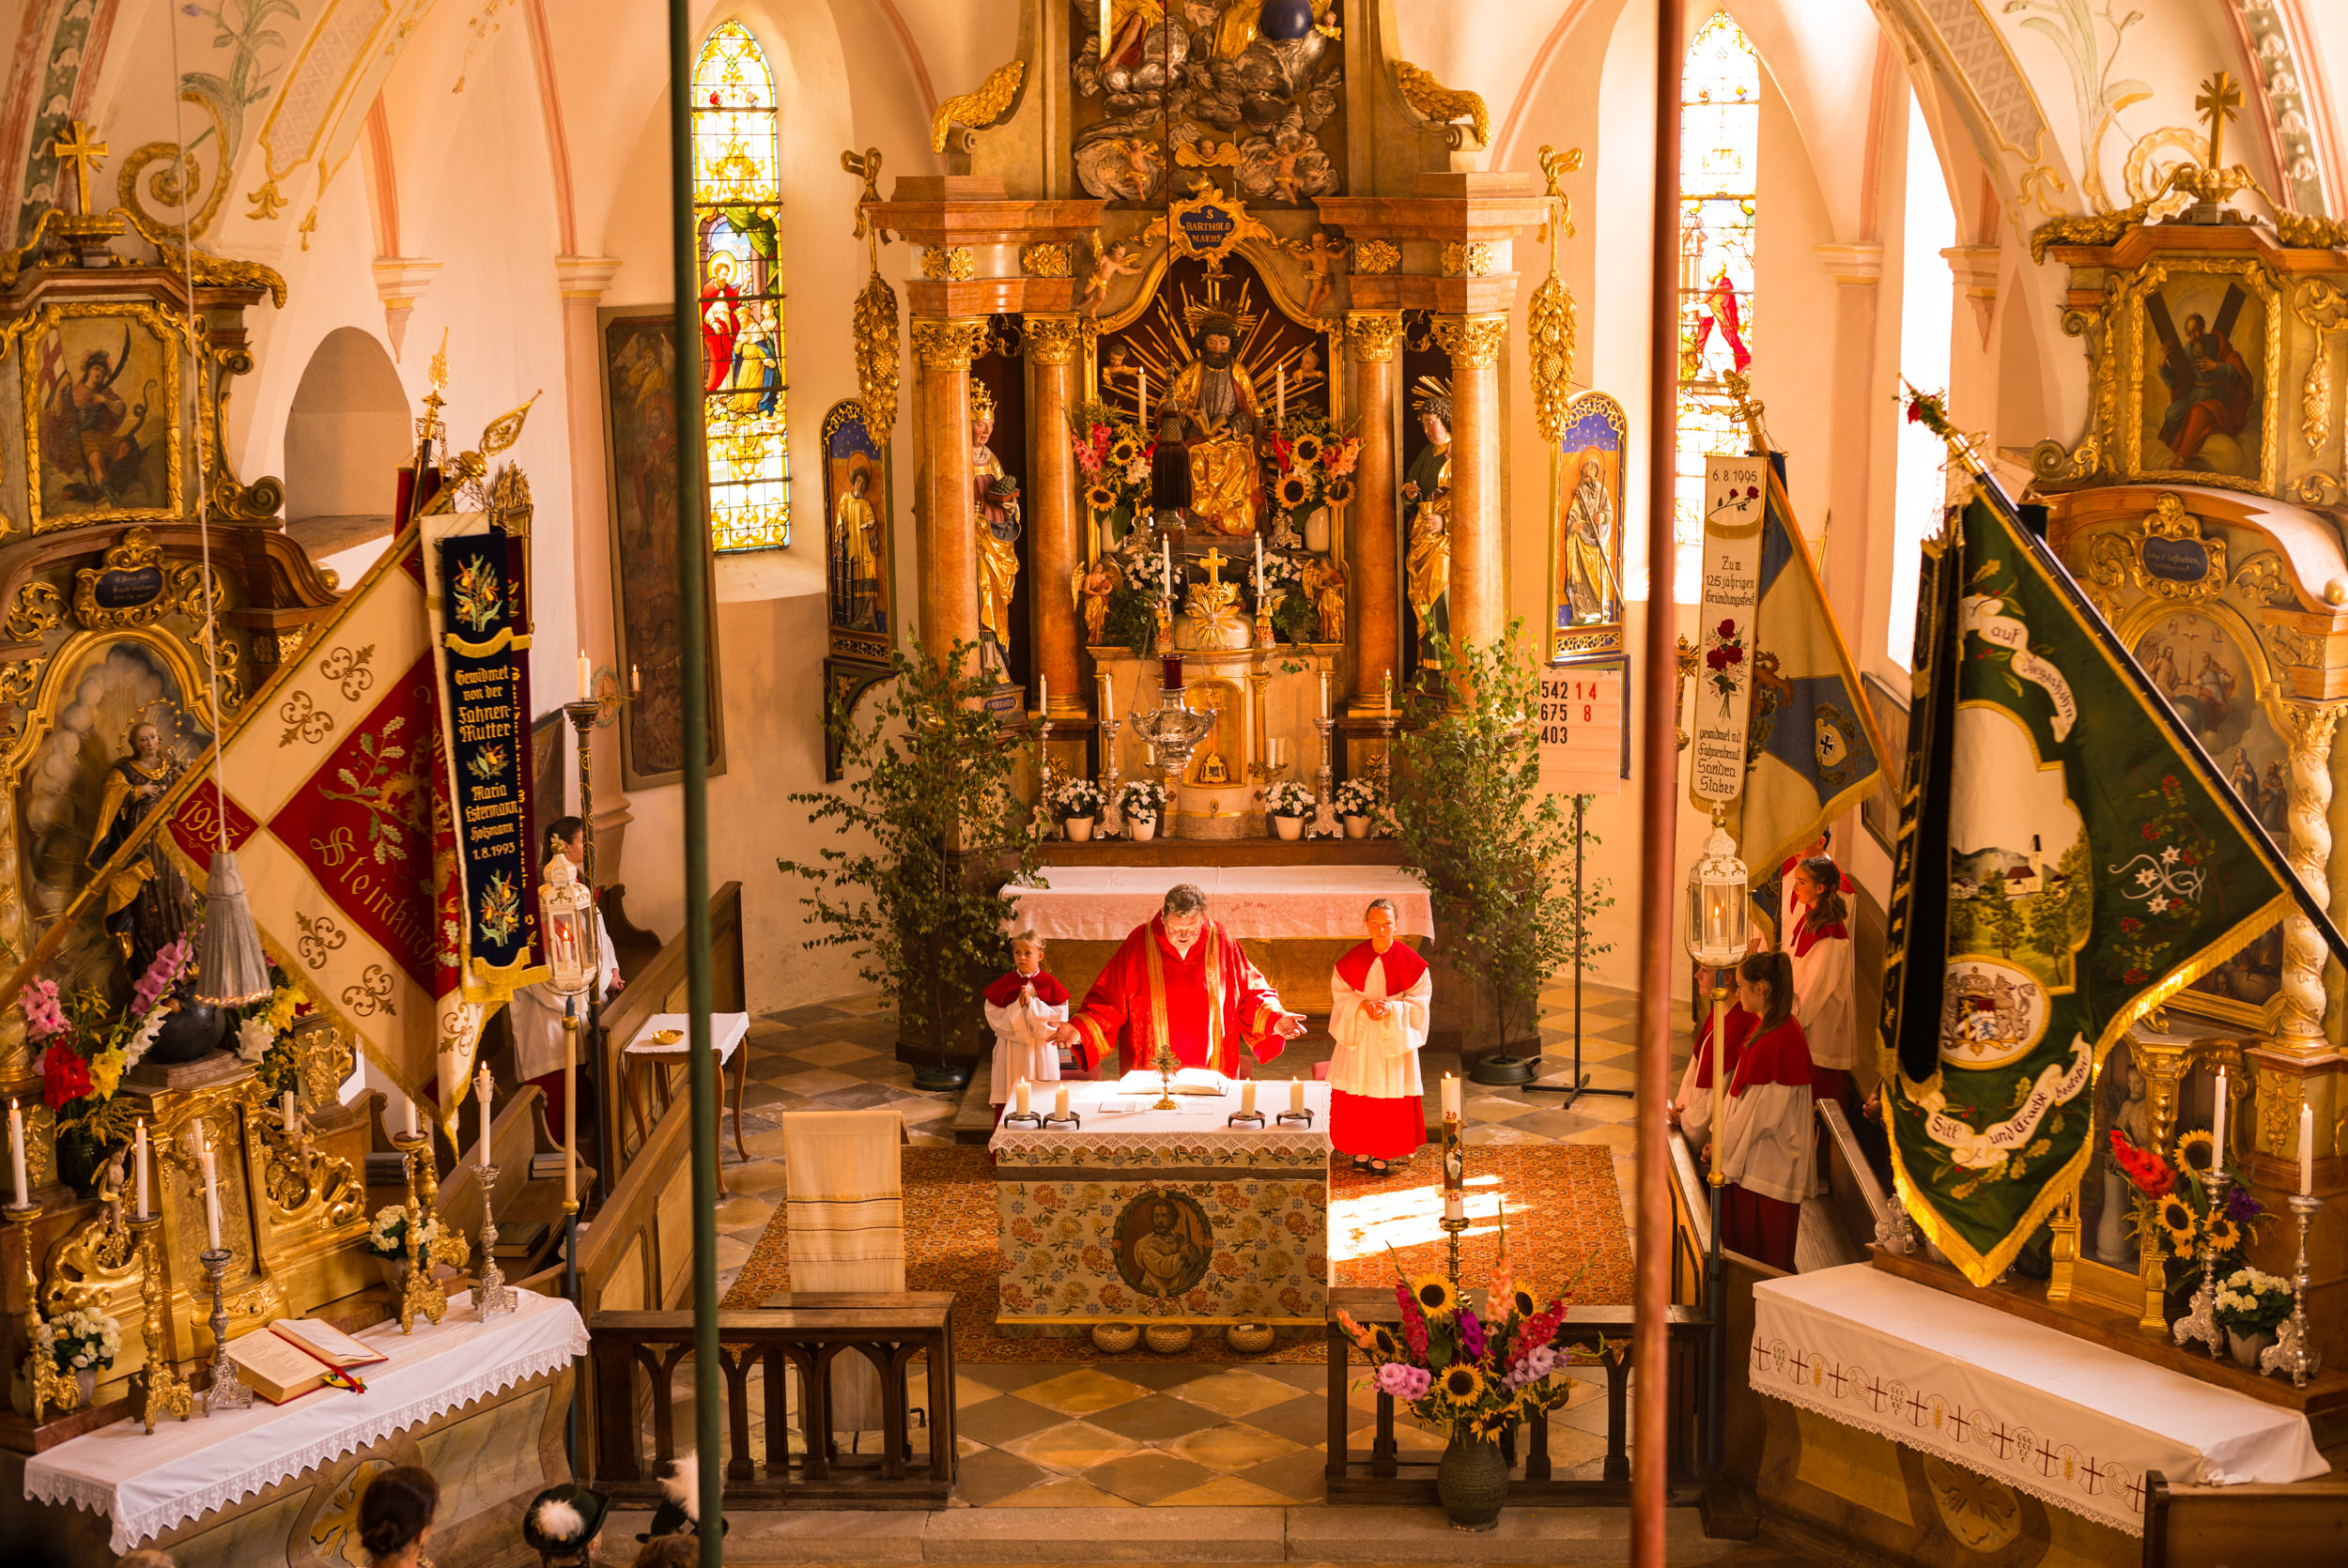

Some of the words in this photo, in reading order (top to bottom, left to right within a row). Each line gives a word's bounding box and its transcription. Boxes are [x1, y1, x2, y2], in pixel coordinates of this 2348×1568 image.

[1185, 222, 1231, 232] BARTHOLO
[1721, 555, 1742, 571] Zum
[454, 664, 510, 686] Gewidmet
[462, 687, 484, 701] von
[484, 684, 503, 699] der
[1541, 681, 1568, 699] 542
[1540, 703, 1568, 722] 675
[1583, 704, 1592, 722] 8
[457, 722, 512, 743] Mutter
[1540, 726, 1568, 745] 403
[1697, 758, 1737, 778] Sandra
[471, 781, 507, 802] Maria
[1698, 776, 1735, 795] Staber
[1445, 1111, 1458, 1120] 20
[1989, 1125, 2015, 1145] und
[1447, 1192, 1460, 1203] 15
